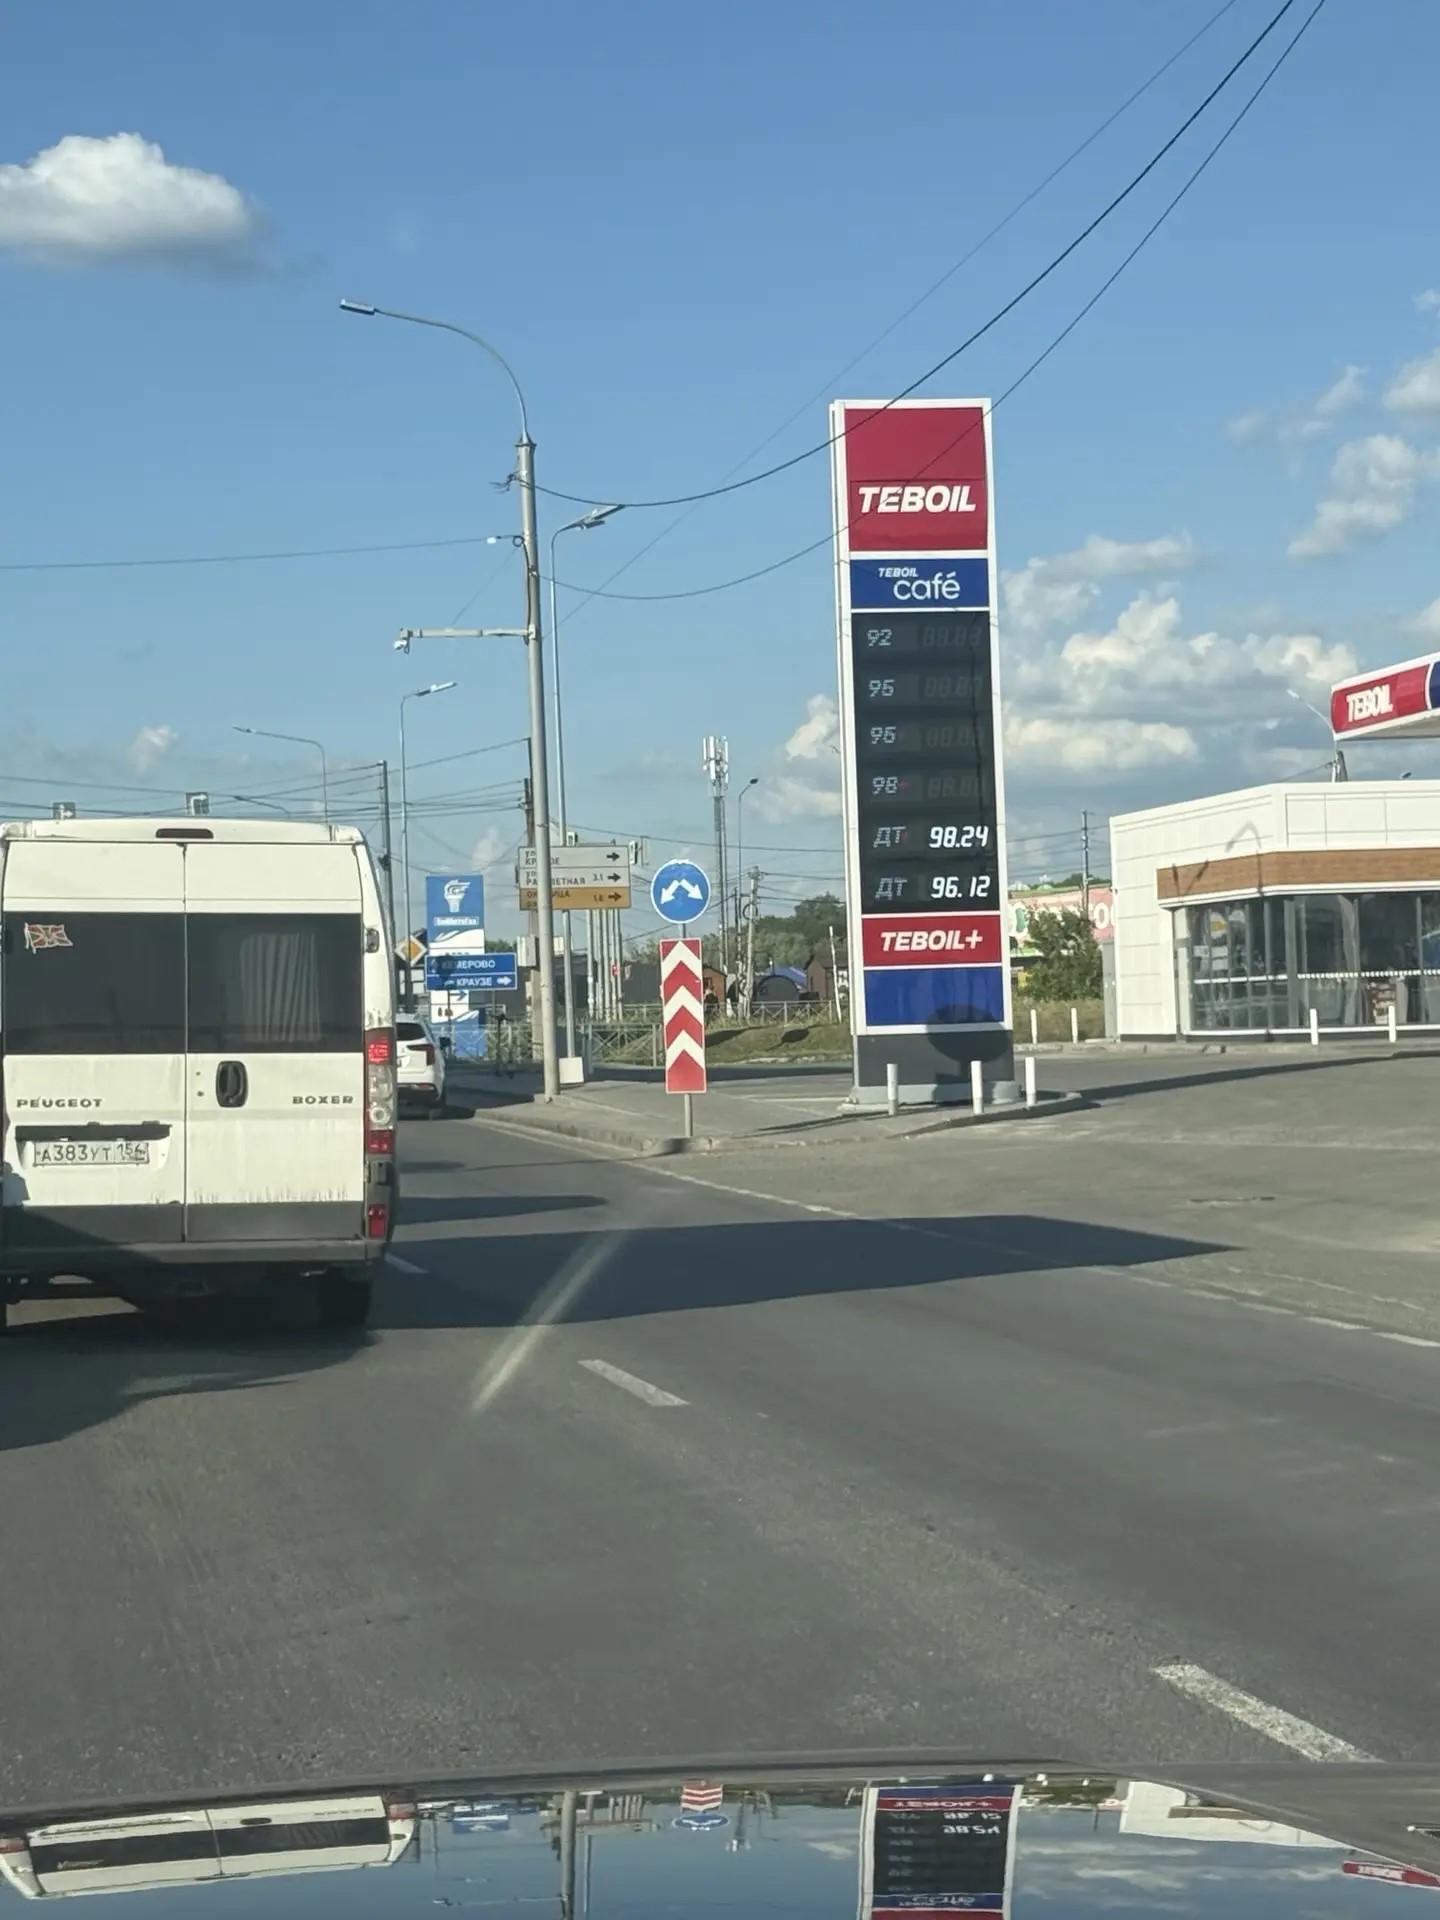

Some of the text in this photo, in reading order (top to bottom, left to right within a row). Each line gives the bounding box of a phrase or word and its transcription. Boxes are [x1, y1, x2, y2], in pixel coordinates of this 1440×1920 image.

[858, 485, 976, 513] TEBOIL
[878, 567, 918, 578] TEBOIL
[893, 572, 960, 600] café
[867, 629, 892, 646] 92
[868, 680, 895, 697] 95
[1346, 684, 1393, 722] TEBOIL
[872, 776, 898, 794] 98
[873, 826, 989, 848] ДТ 98.24
[930, 875, 991, 898] 96.12
[880, 929, 983, 951] TEBOIL+
[456, 977, 492, 986] КРАУЗЕ
[16, 1098, 103, 1108] PEUGEOT
[292, 1095, 354, 1105] BOXER
